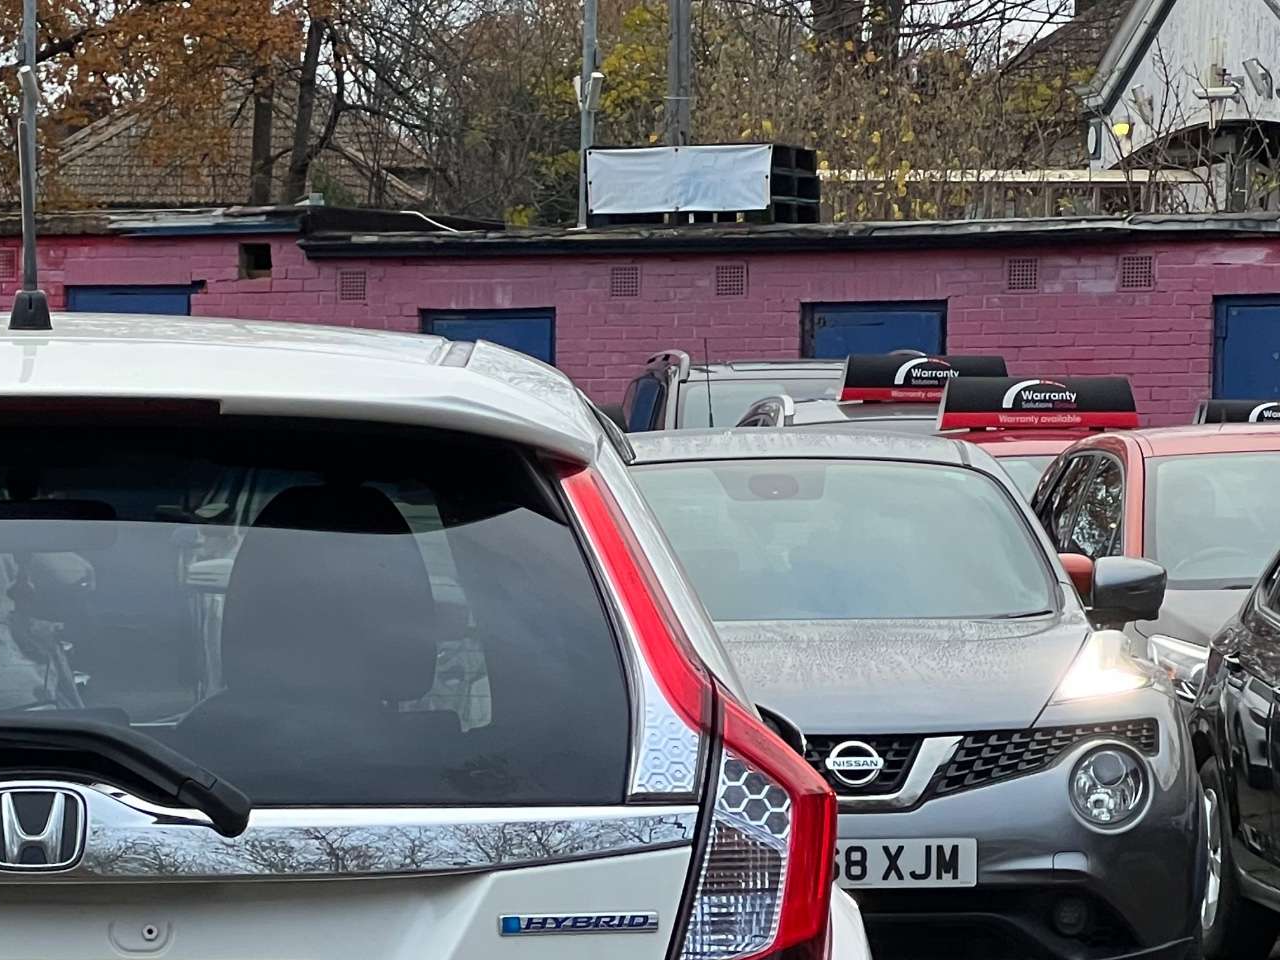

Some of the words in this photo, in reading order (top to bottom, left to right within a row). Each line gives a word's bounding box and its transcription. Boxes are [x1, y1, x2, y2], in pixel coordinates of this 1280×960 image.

[911, 368, 960, 378] Warranty
[1021, 390, 1077, 403] Warranty
[1021, 401, 1053, 409] Solutions
[998, 414, 1039, 424] Warranty
[1040, 414, 1082, 423] available
[832, 759, 879, 768] NISSAN
[881, 844, 960, 881] XJM
[523, 914, 650, 930] HYBRID
